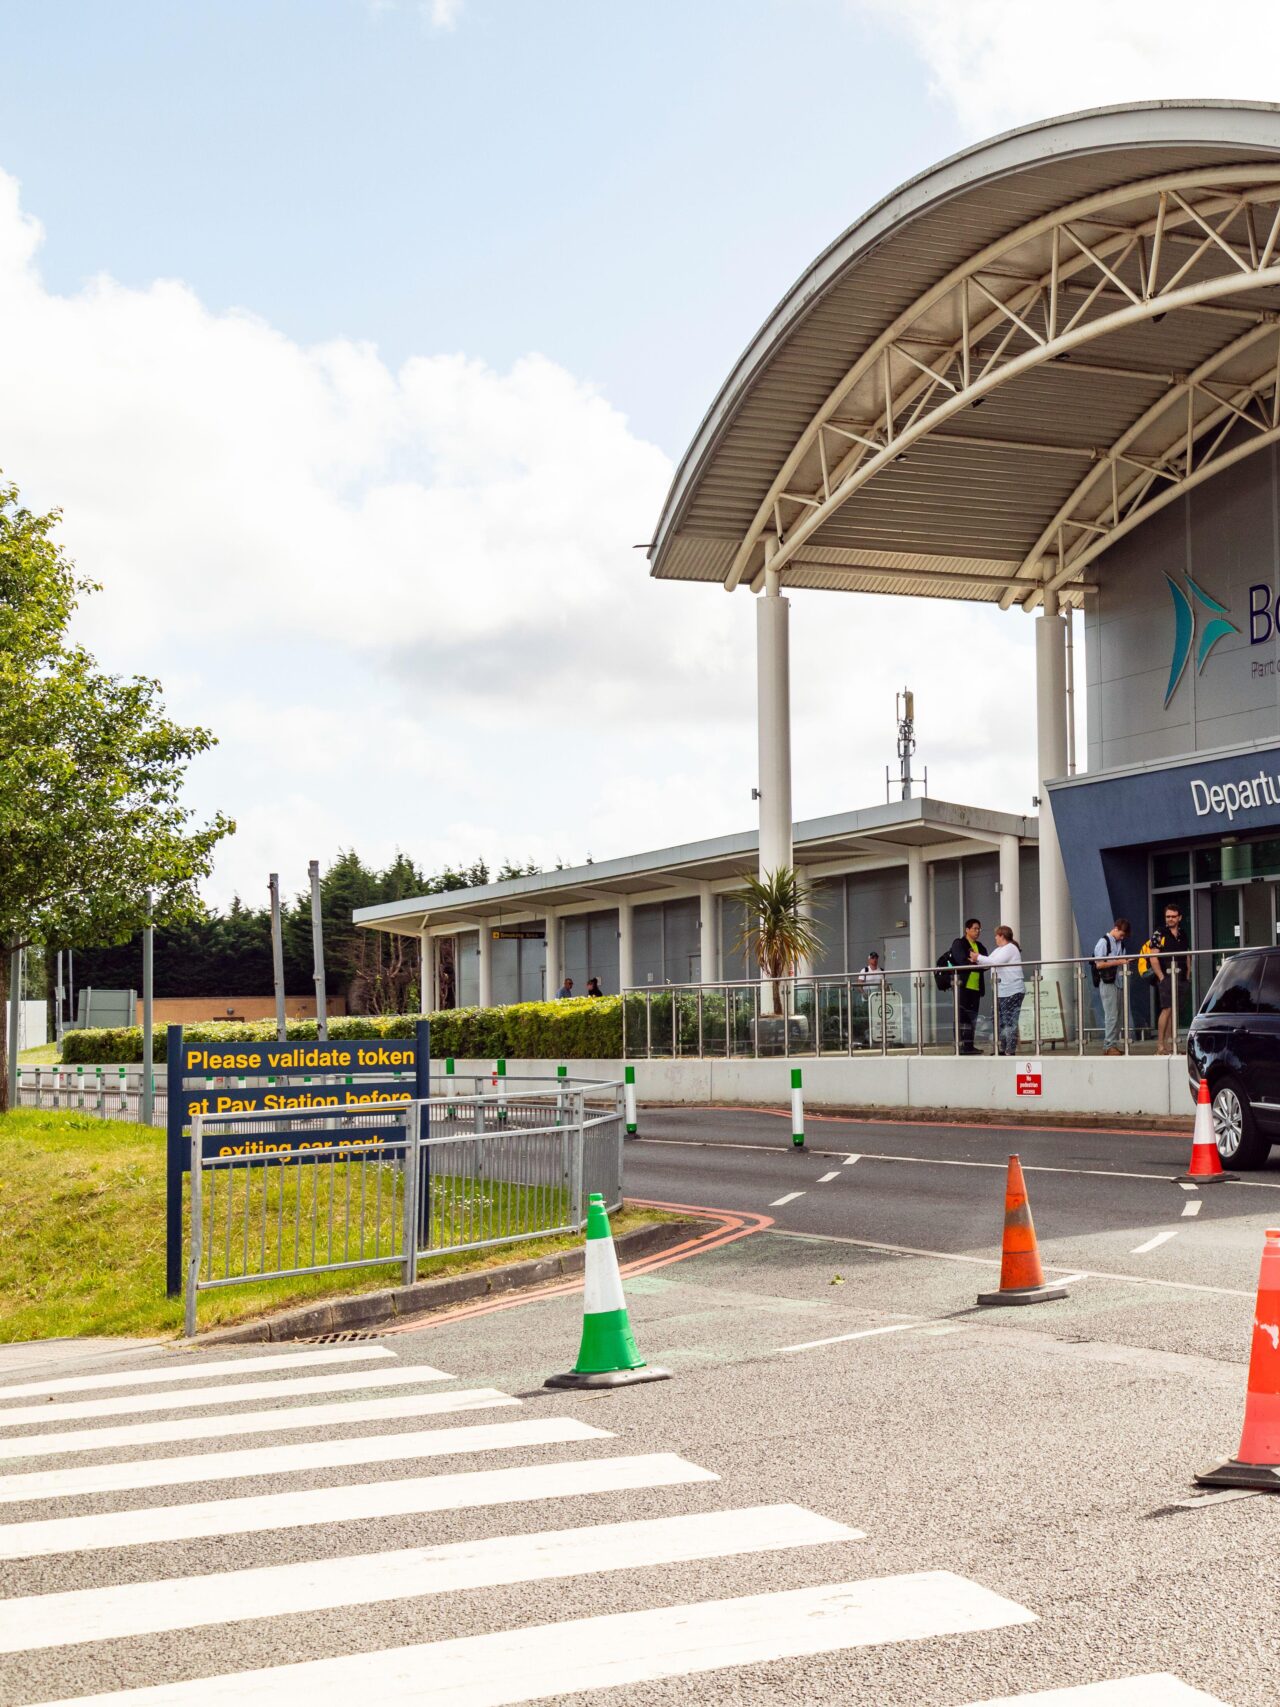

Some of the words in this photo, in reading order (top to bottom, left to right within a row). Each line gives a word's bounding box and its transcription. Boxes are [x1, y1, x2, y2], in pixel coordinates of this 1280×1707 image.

[1252, 659, 1275, 679] Part
[187, 1050, 261, 1069] Please
[268, 1048, 351, 1067] validate
[358, 1047, 415, 1066] token
[188, 1097, 209, 1117] at
[264, 1092, 339, 1111] Station
[345, 1089, 412, 1107] before
[219, 1139, 292, 1163] exiting
